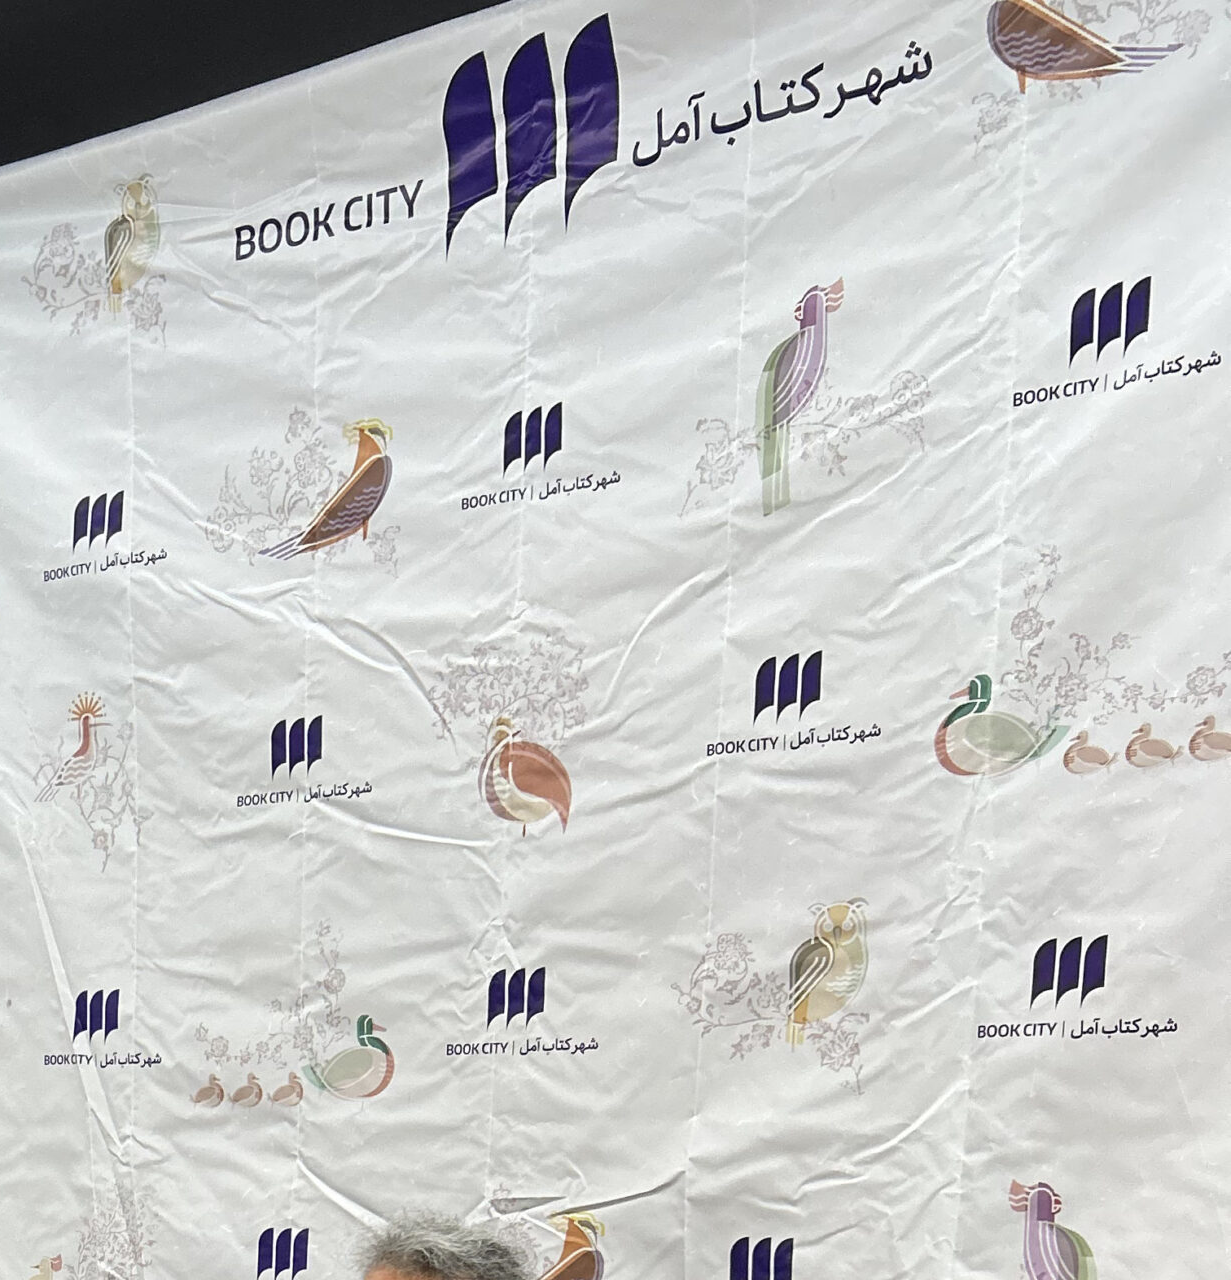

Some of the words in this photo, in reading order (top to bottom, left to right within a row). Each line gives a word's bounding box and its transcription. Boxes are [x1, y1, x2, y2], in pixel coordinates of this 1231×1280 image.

[632, 91, 705, 167] آمل
[235, 202, 336, 261] BOOK
[344, 179, 424, 232] CITY
[1113, 363, 1145, 391] آمل
[1012, 384, 1061, 408] BOOK
[1062, 376, 1100, 398] CITY
[461, 492, 497, 511] BOOK
[498, 486, 527, 504] CITY
[538, 478, 562, 501] آمل
[43, 566, 71, 582] BOOK
[70, 561, 92, 577] CITY
[99, 552, 119, 572] آمل
[706, 739, 746, 757] BOOK
[747, 736, 780, 752] CITY
[789, 727, 816, 751] آمل
[236, 792, 268, 808] BOOK
[269, 789, 294, 804] CITY
[303, 784, 323, 804] آمل
[977, 1023, 1021, 1039] BOOK
[1023, 1022, 1058, 1037] CITY
[1070, 1017, 1101, 1040] آمل
[446, 1042, 480, 1056] BOOK
[481, 1041, 509, 1055] CITY
[519, 1036, 542, 1056] آمل
[43, 1054, 71, 1066] BOOK
[99, 1051, 118, 1069] آمل
